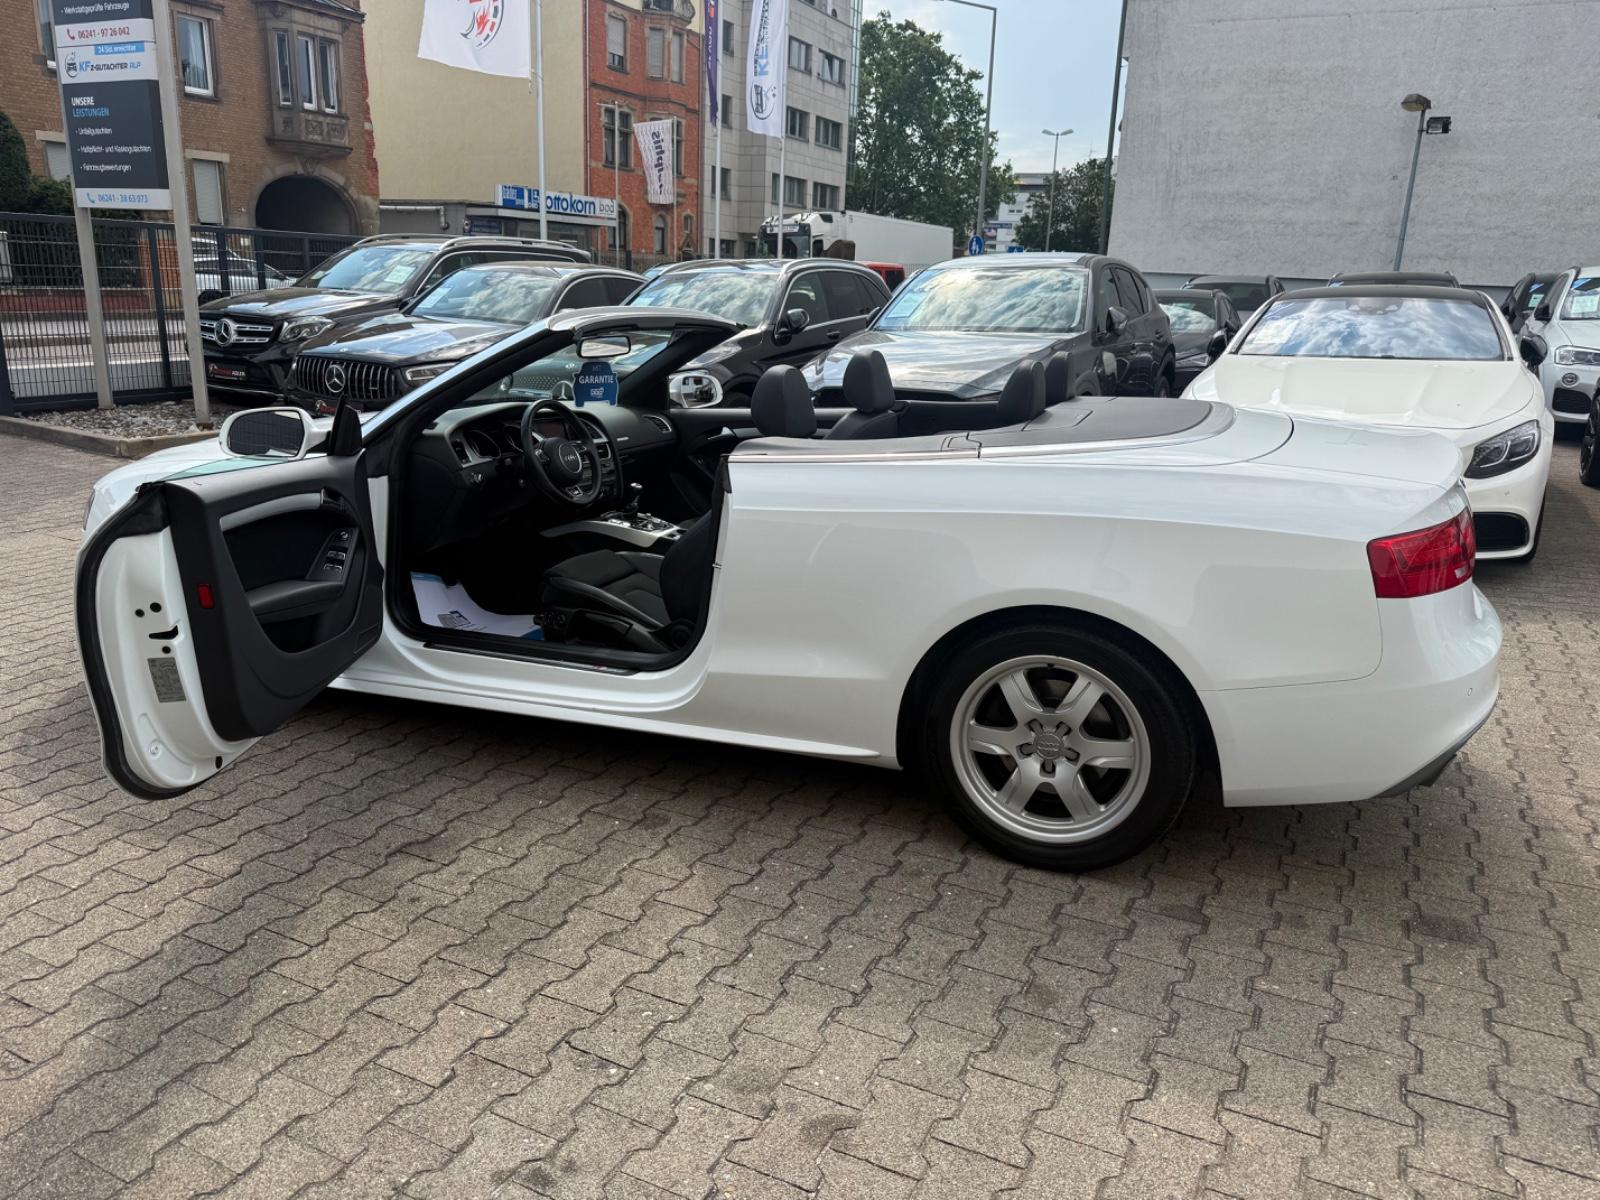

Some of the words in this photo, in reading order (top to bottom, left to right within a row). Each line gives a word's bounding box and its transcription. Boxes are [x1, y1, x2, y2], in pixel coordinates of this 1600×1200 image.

[104, 2, 129, 11] Fahrzeuge
[78, 29, 96, 39] 06241
[101, 28, 109, 37] 97
[110, 28, 118, 37] 26
[118, 27, 130, 36] 042
[71, 96, 95, 106] UNSERE
[72, 107, 110, 117] LEISTUNGEN
[97, 193, 116, 203] 06241
[546, 192, 596, 215] ottokorn
[578, 375, 614, 384] GARANTIE
